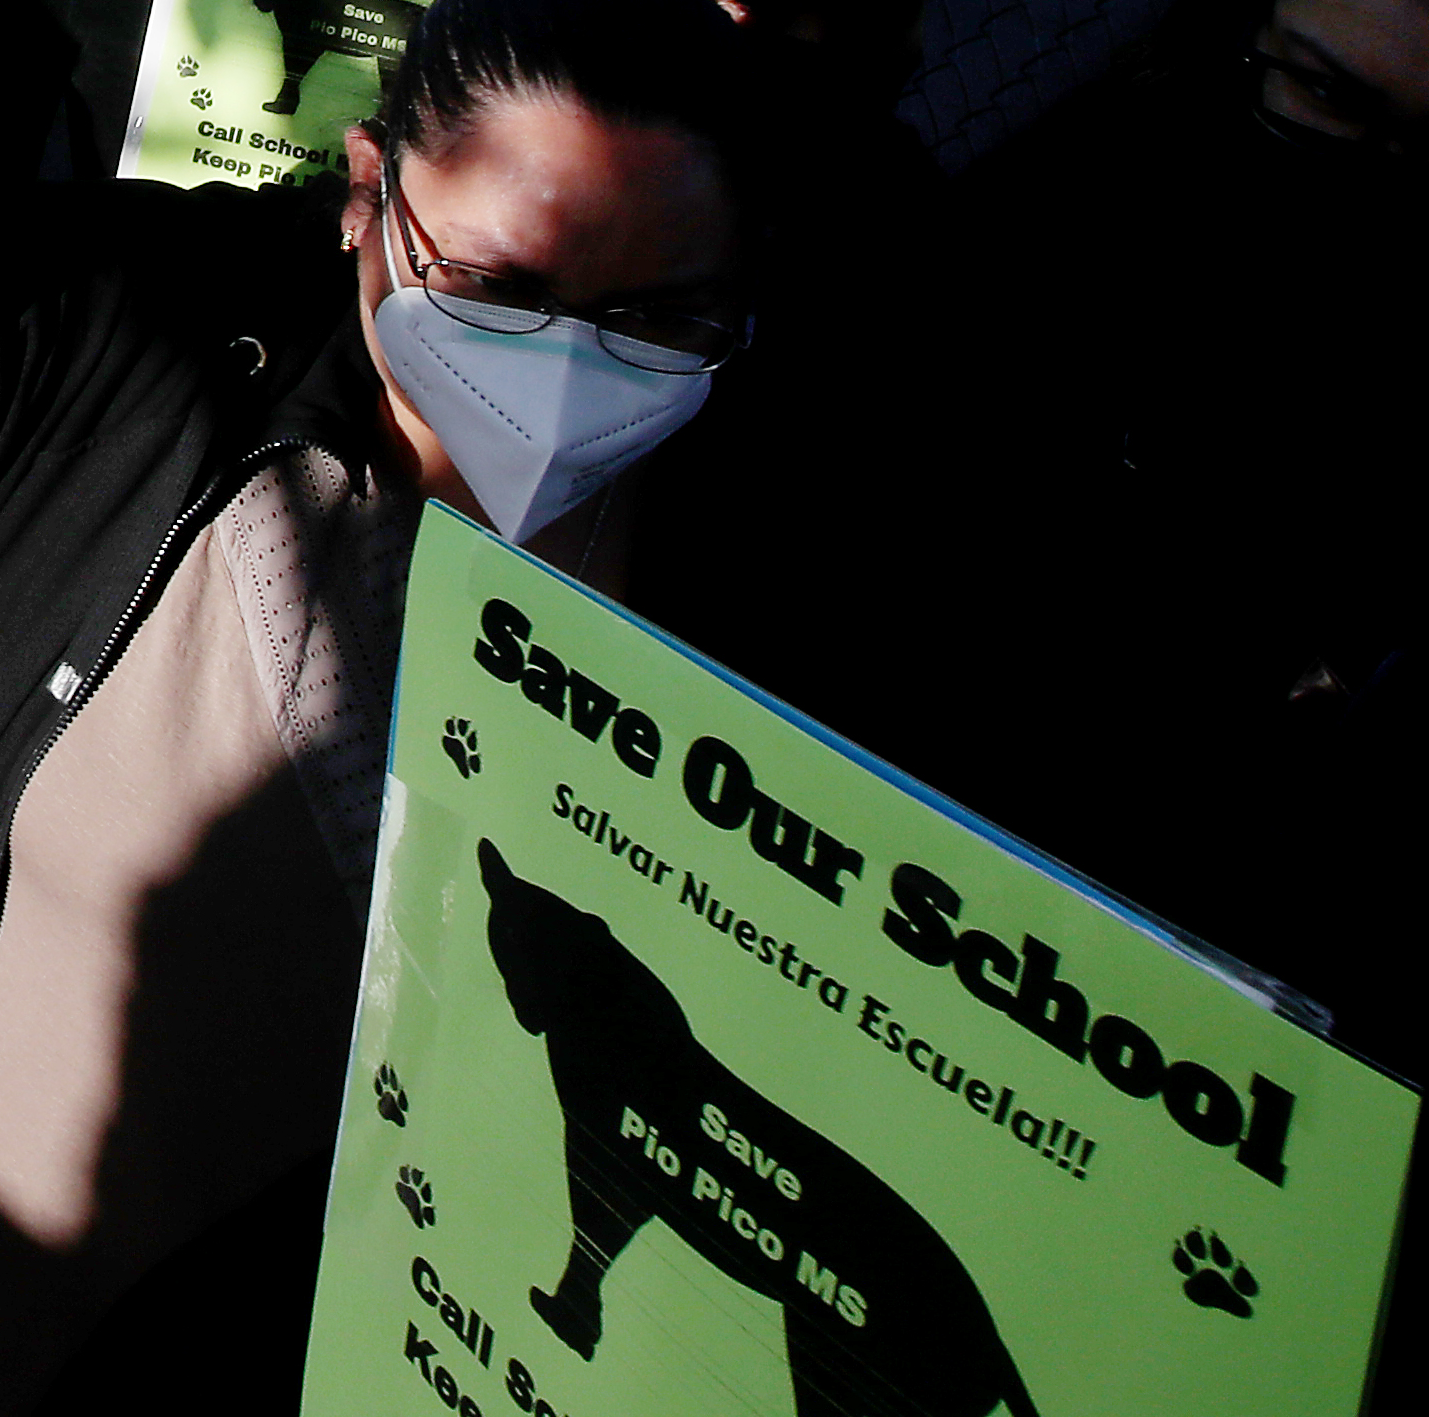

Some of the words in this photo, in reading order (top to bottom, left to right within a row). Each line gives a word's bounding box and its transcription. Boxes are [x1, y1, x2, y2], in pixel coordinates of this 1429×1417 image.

[310, 18, 336, 38] Pio
[340, 26, 379, 48] Pico
[381, 32, 407, 53] MS
[343, 3, 385, 26] Save
[192, 147, 252, 179] Keep
[197, 120, 242, 146] Call
[248, 132, 329, 167] School
[473, 597, 662, 778] Save
[682, 735, 864, 907] Our
[880, 861, 1298, 1189] School
[552, 782, 675, 886] Salvar
[678, 870, 849, 1014] Nuestra
[857, 995, 1098, 1182] Escuela!!!
[699, 1101, 803, 1202] Save
[620, 1106, 682, 1178] Pio
[690, 1166, 785, 1266] Pico
[795, 1260, 869, 1330] MS
[412, 1256, 494, 1370] Call
[404, 1319, 483, 1417] Kee
